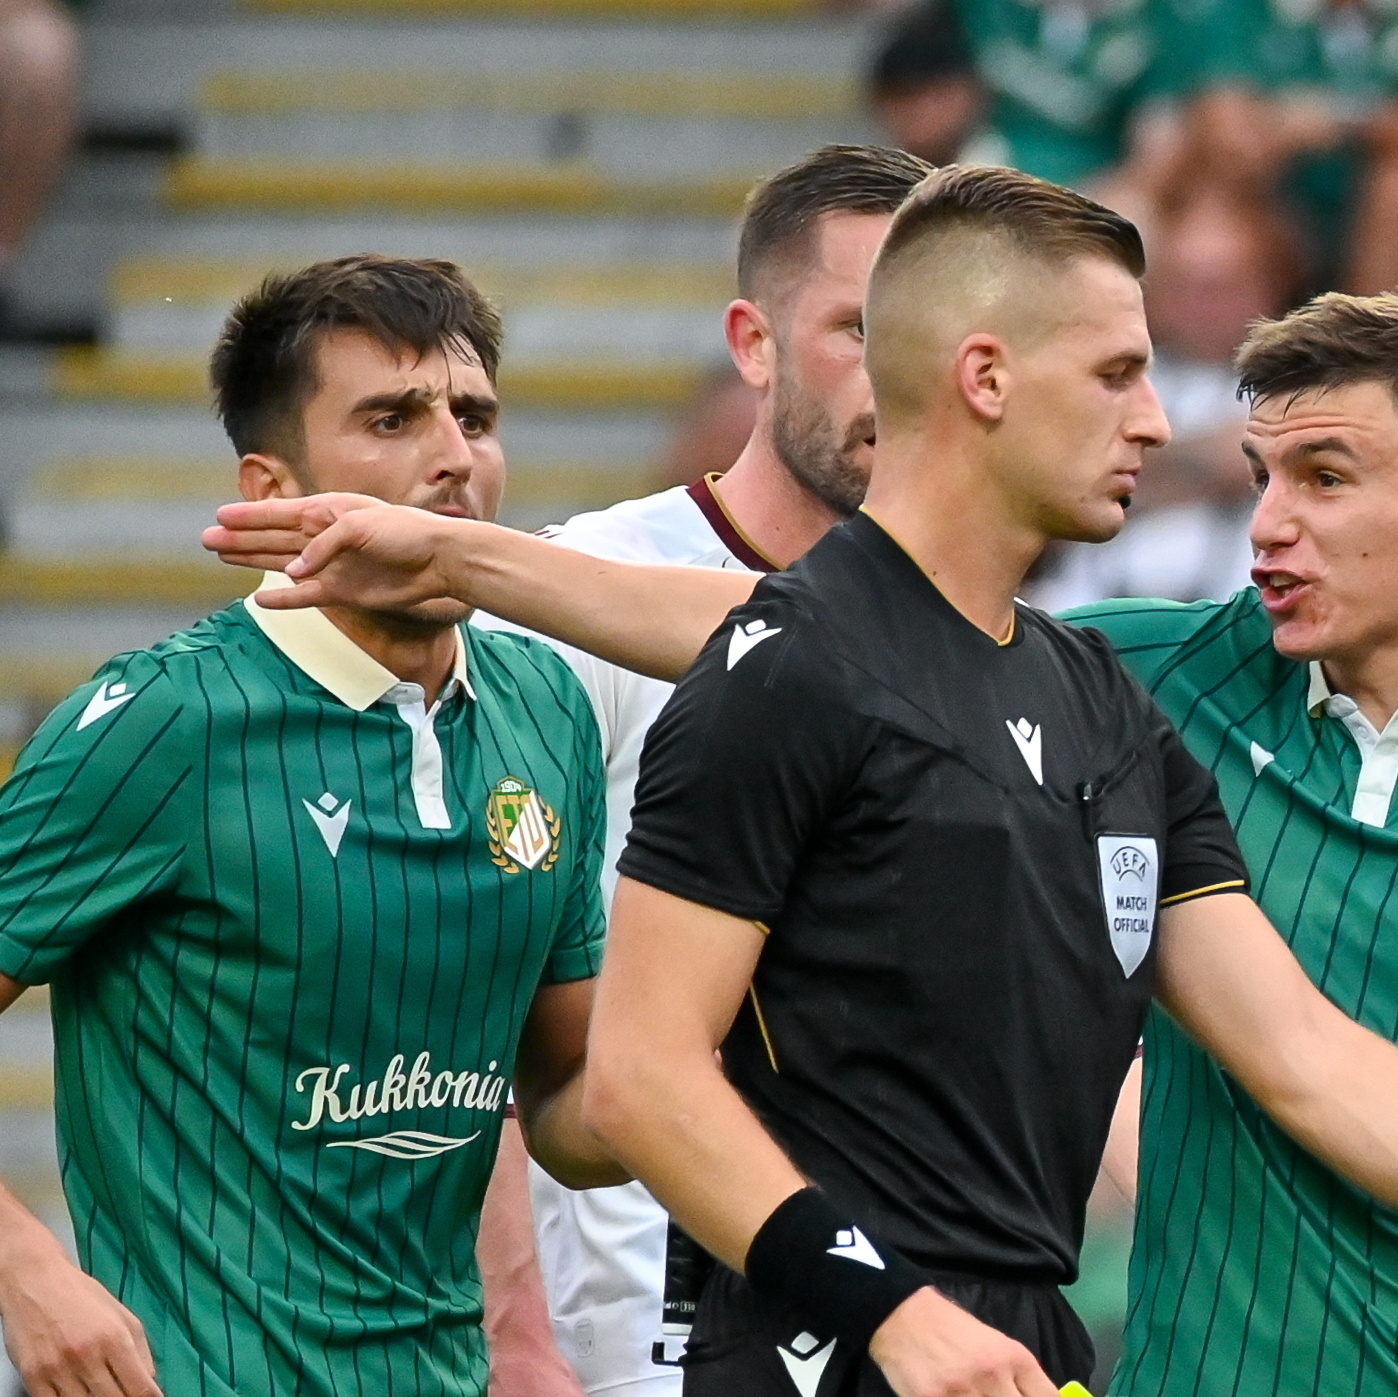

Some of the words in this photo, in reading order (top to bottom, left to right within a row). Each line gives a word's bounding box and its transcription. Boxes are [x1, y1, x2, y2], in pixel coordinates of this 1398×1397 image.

[1113, 852, 1147, 878] UEFA
[1116, 896, 1147, 911] MATCH
[1113, 917, 1150, 933] OFFICIAL
[291, 1051, 506, 1131] Kukkonia
